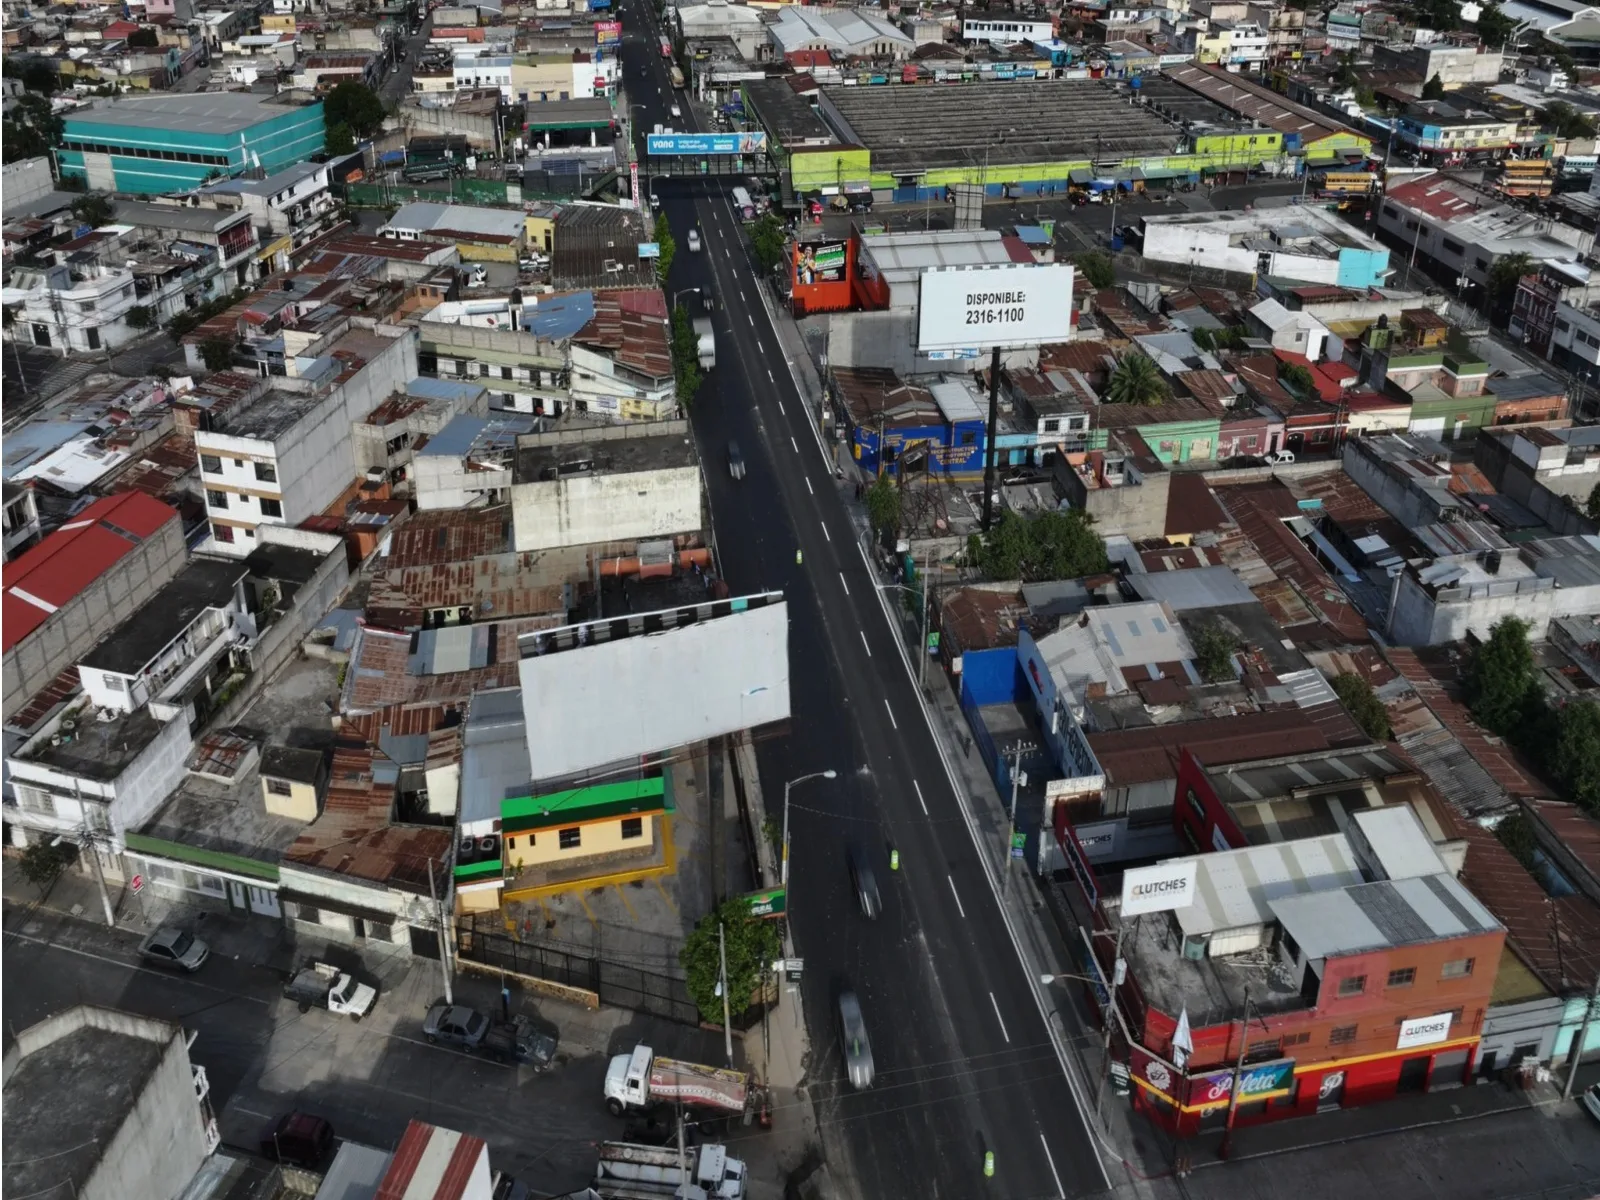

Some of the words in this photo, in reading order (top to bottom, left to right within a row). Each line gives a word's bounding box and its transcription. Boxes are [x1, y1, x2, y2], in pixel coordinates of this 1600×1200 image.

[966, 291, 1026, 305] DISPONIBLE:
[966, 307, 1024, 324] 2316-1100
[1131, 878, 1187, 896] CLUTCHES
[1405, 1022, 1445, 1036] CLUTCHES
[1208, 1073, 1277, 1099] Pleta
